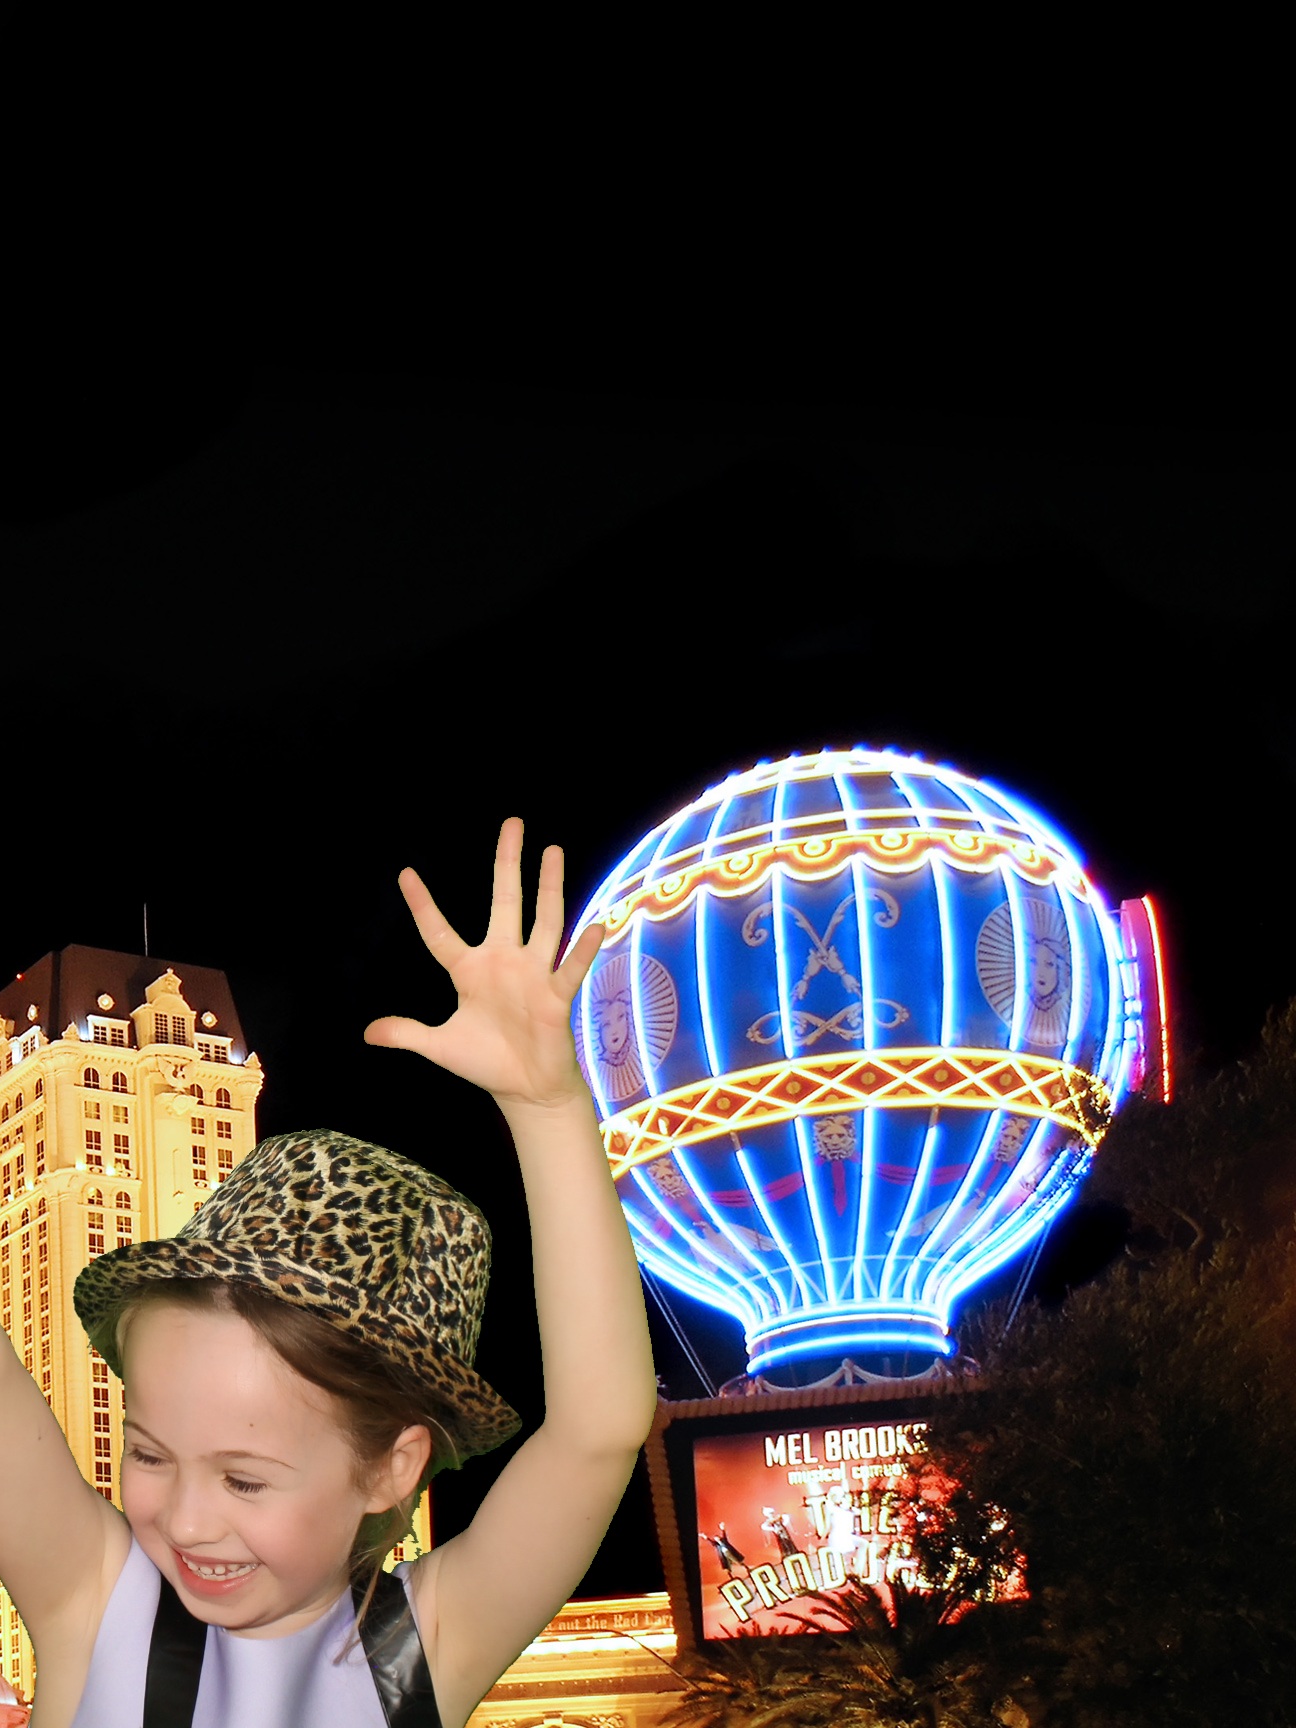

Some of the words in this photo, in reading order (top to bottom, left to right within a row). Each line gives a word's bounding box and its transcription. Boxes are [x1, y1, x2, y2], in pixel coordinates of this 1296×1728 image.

[764, 1433, 819, 1468] MEL
[787, 1461, 846, 1486] musical
[585, 1614, 608, 1630] the
